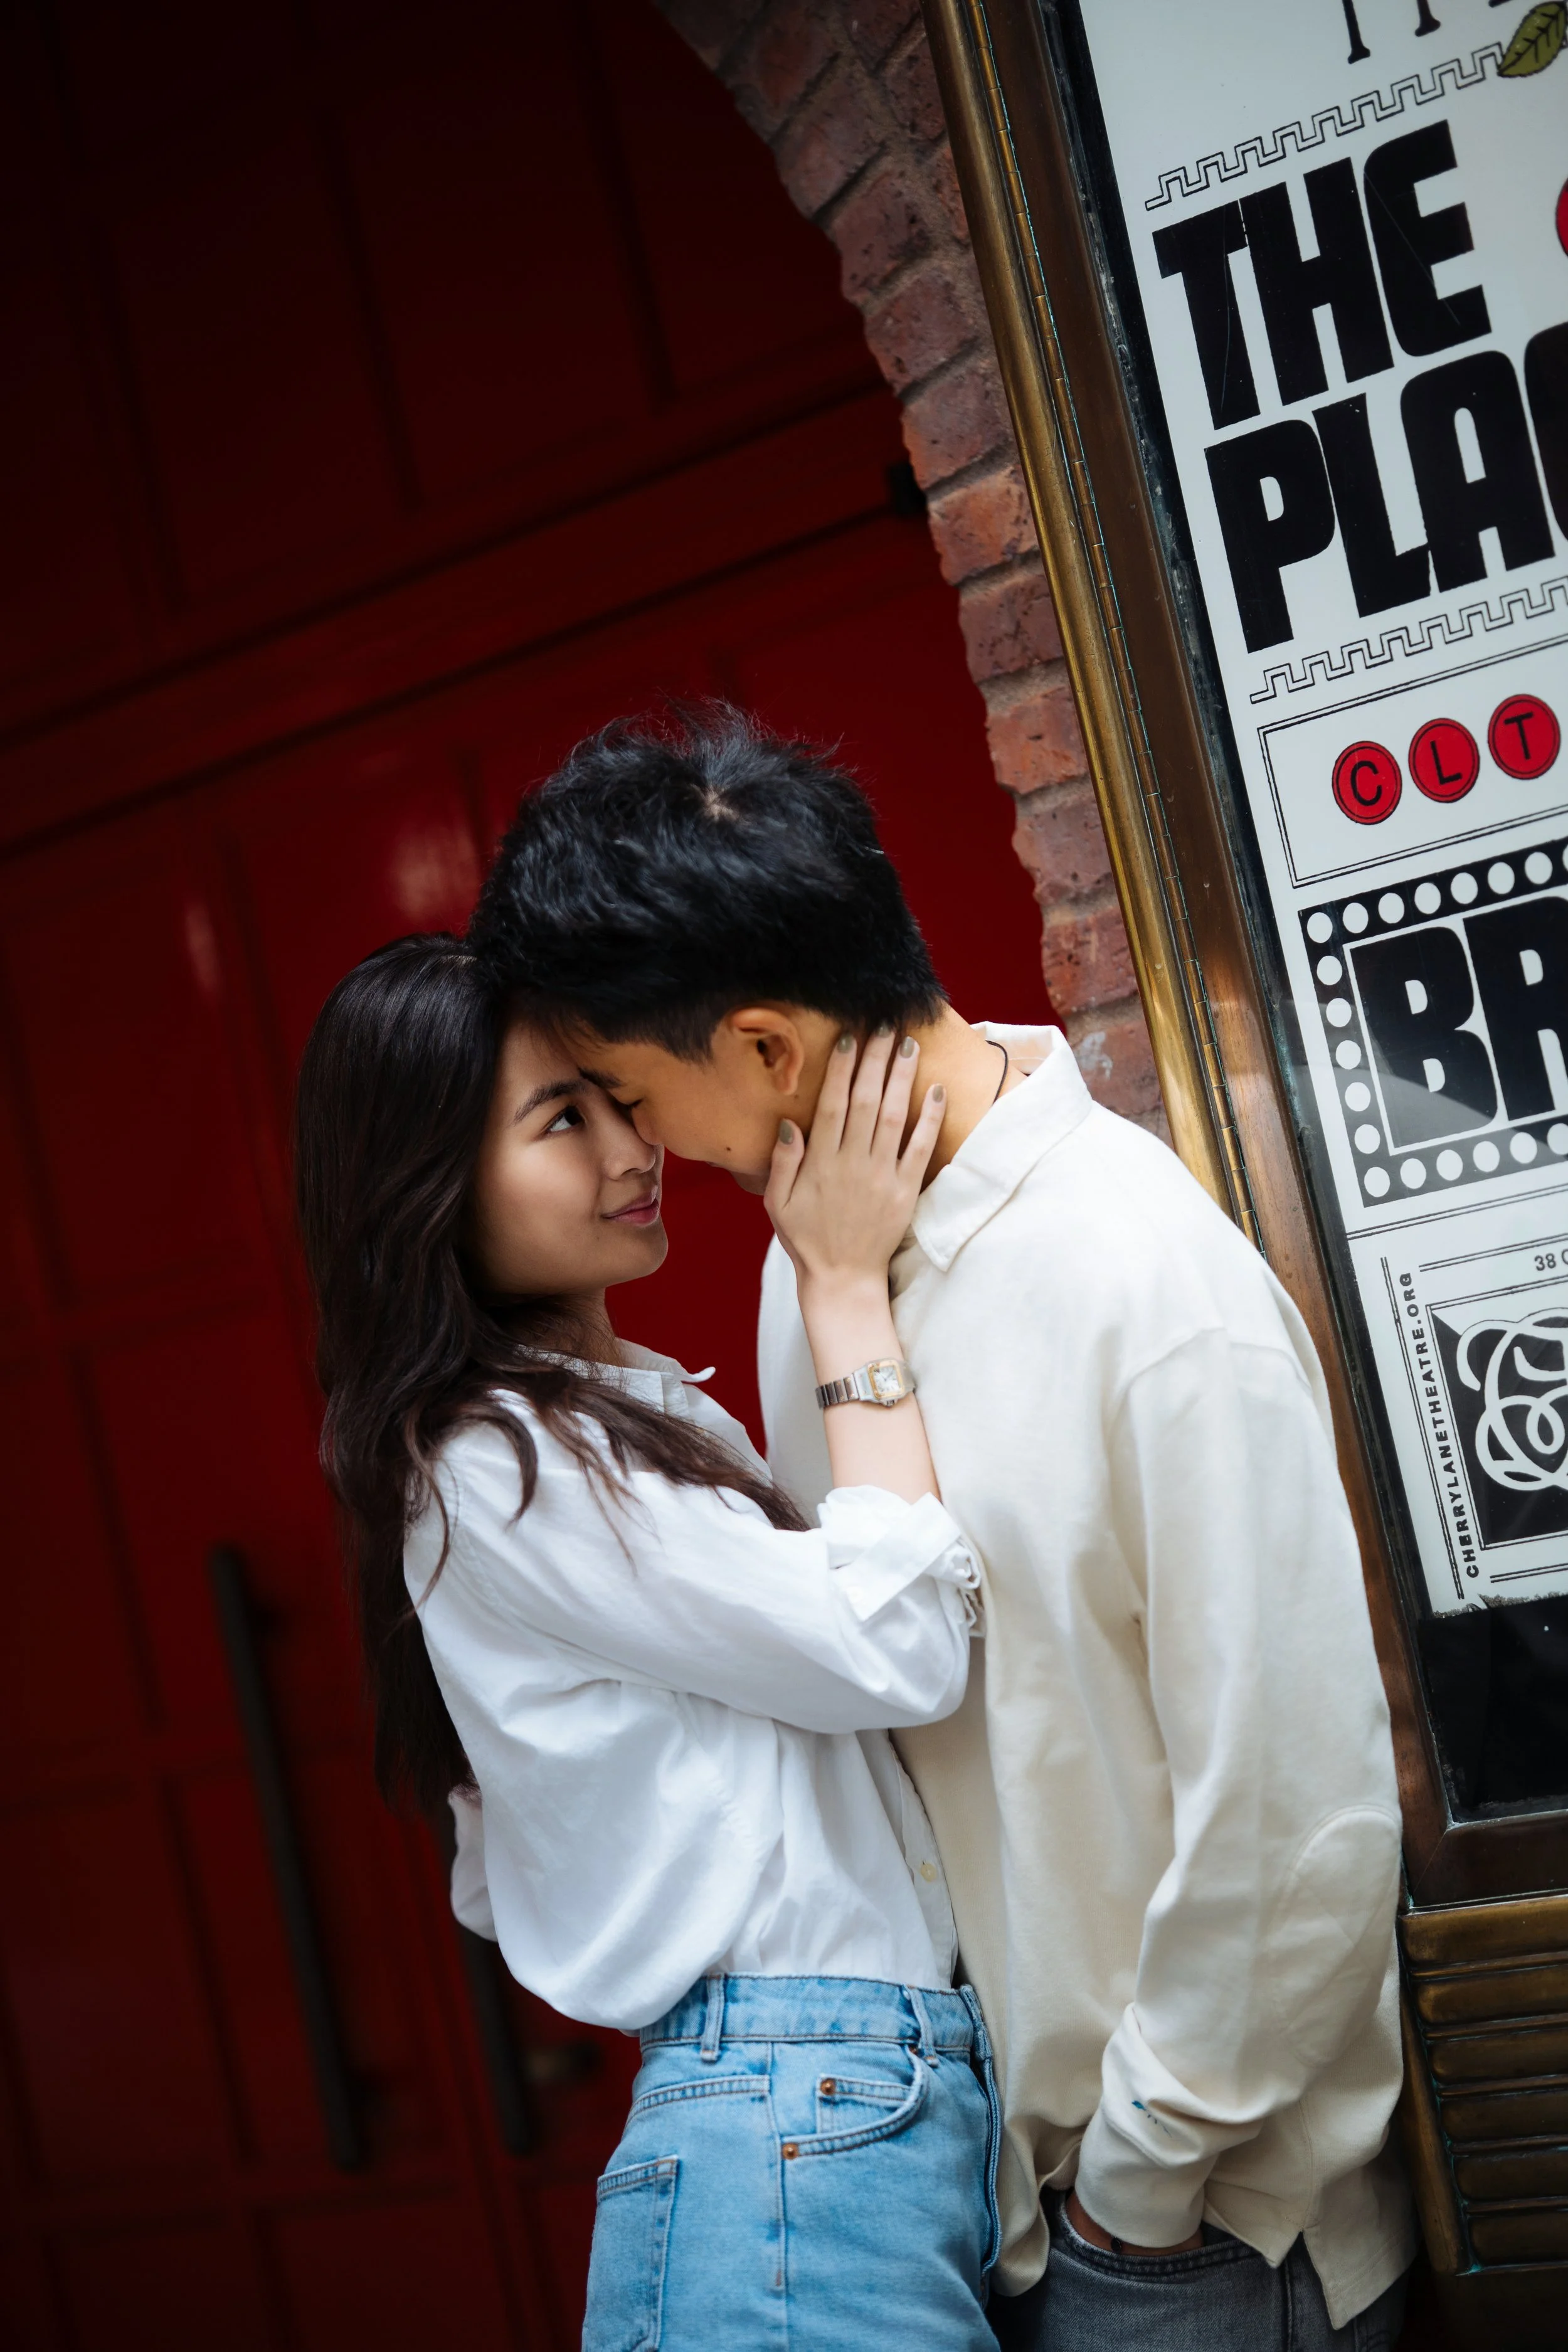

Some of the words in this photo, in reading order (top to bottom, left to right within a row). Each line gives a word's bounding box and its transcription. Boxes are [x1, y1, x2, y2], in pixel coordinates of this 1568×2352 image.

[1152, 119, 1492, 431] THE
[1534, 1253, 1557, 1271] 38
[1399, 1273, 1480, 1578] CHERRYLANETHEATRE.ORG
